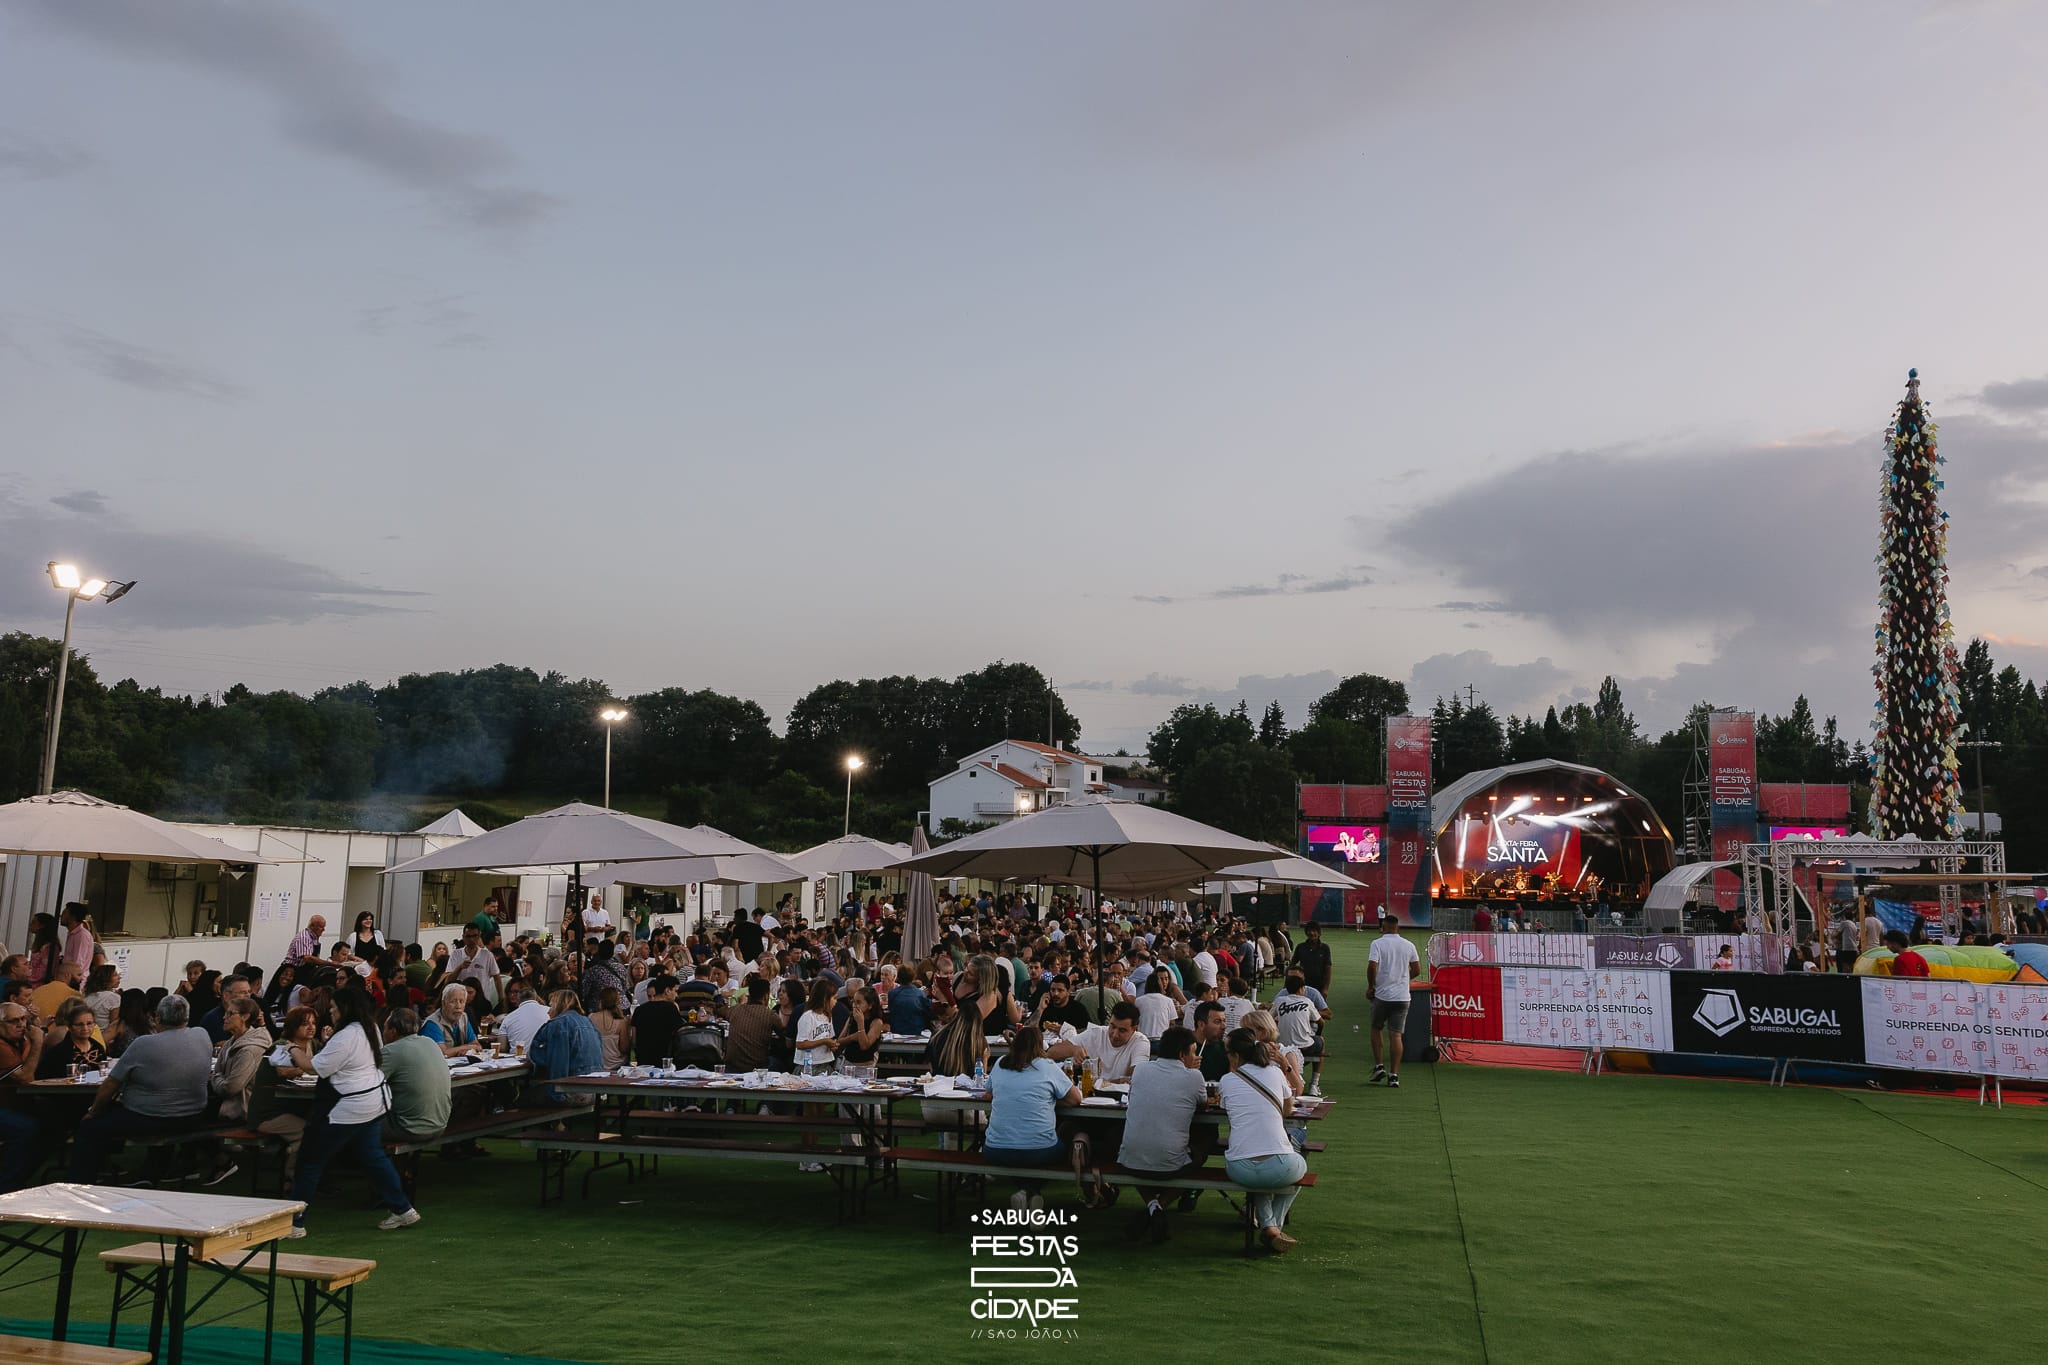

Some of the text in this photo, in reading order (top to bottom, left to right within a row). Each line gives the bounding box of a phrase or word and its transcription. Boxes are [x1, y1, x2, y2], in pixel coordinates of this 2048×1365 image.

[1392, 779, 1426, 788] FESTAS
[1716, 776, 1751, 785] FESTAS
[1402, 842, 1413, 852] 18
[1727, 840, 1738, 850] 18
[1401, 854, 1413, 864] 22
[1487, 847, 1548, 862] SANTA
[1727, 853, 1739, 861] 22
[1431, 994, 1484, 1011] BUGAL
[1519, 1003, 1653, 1015] SURPREENDA OS SENTIDOS
[1749, 1006, 1840, 1027] SABUGAL
[1886, 1019, 1969, 1033] SURPREENDA
[1972, 1024, 1992, 1034] OS
